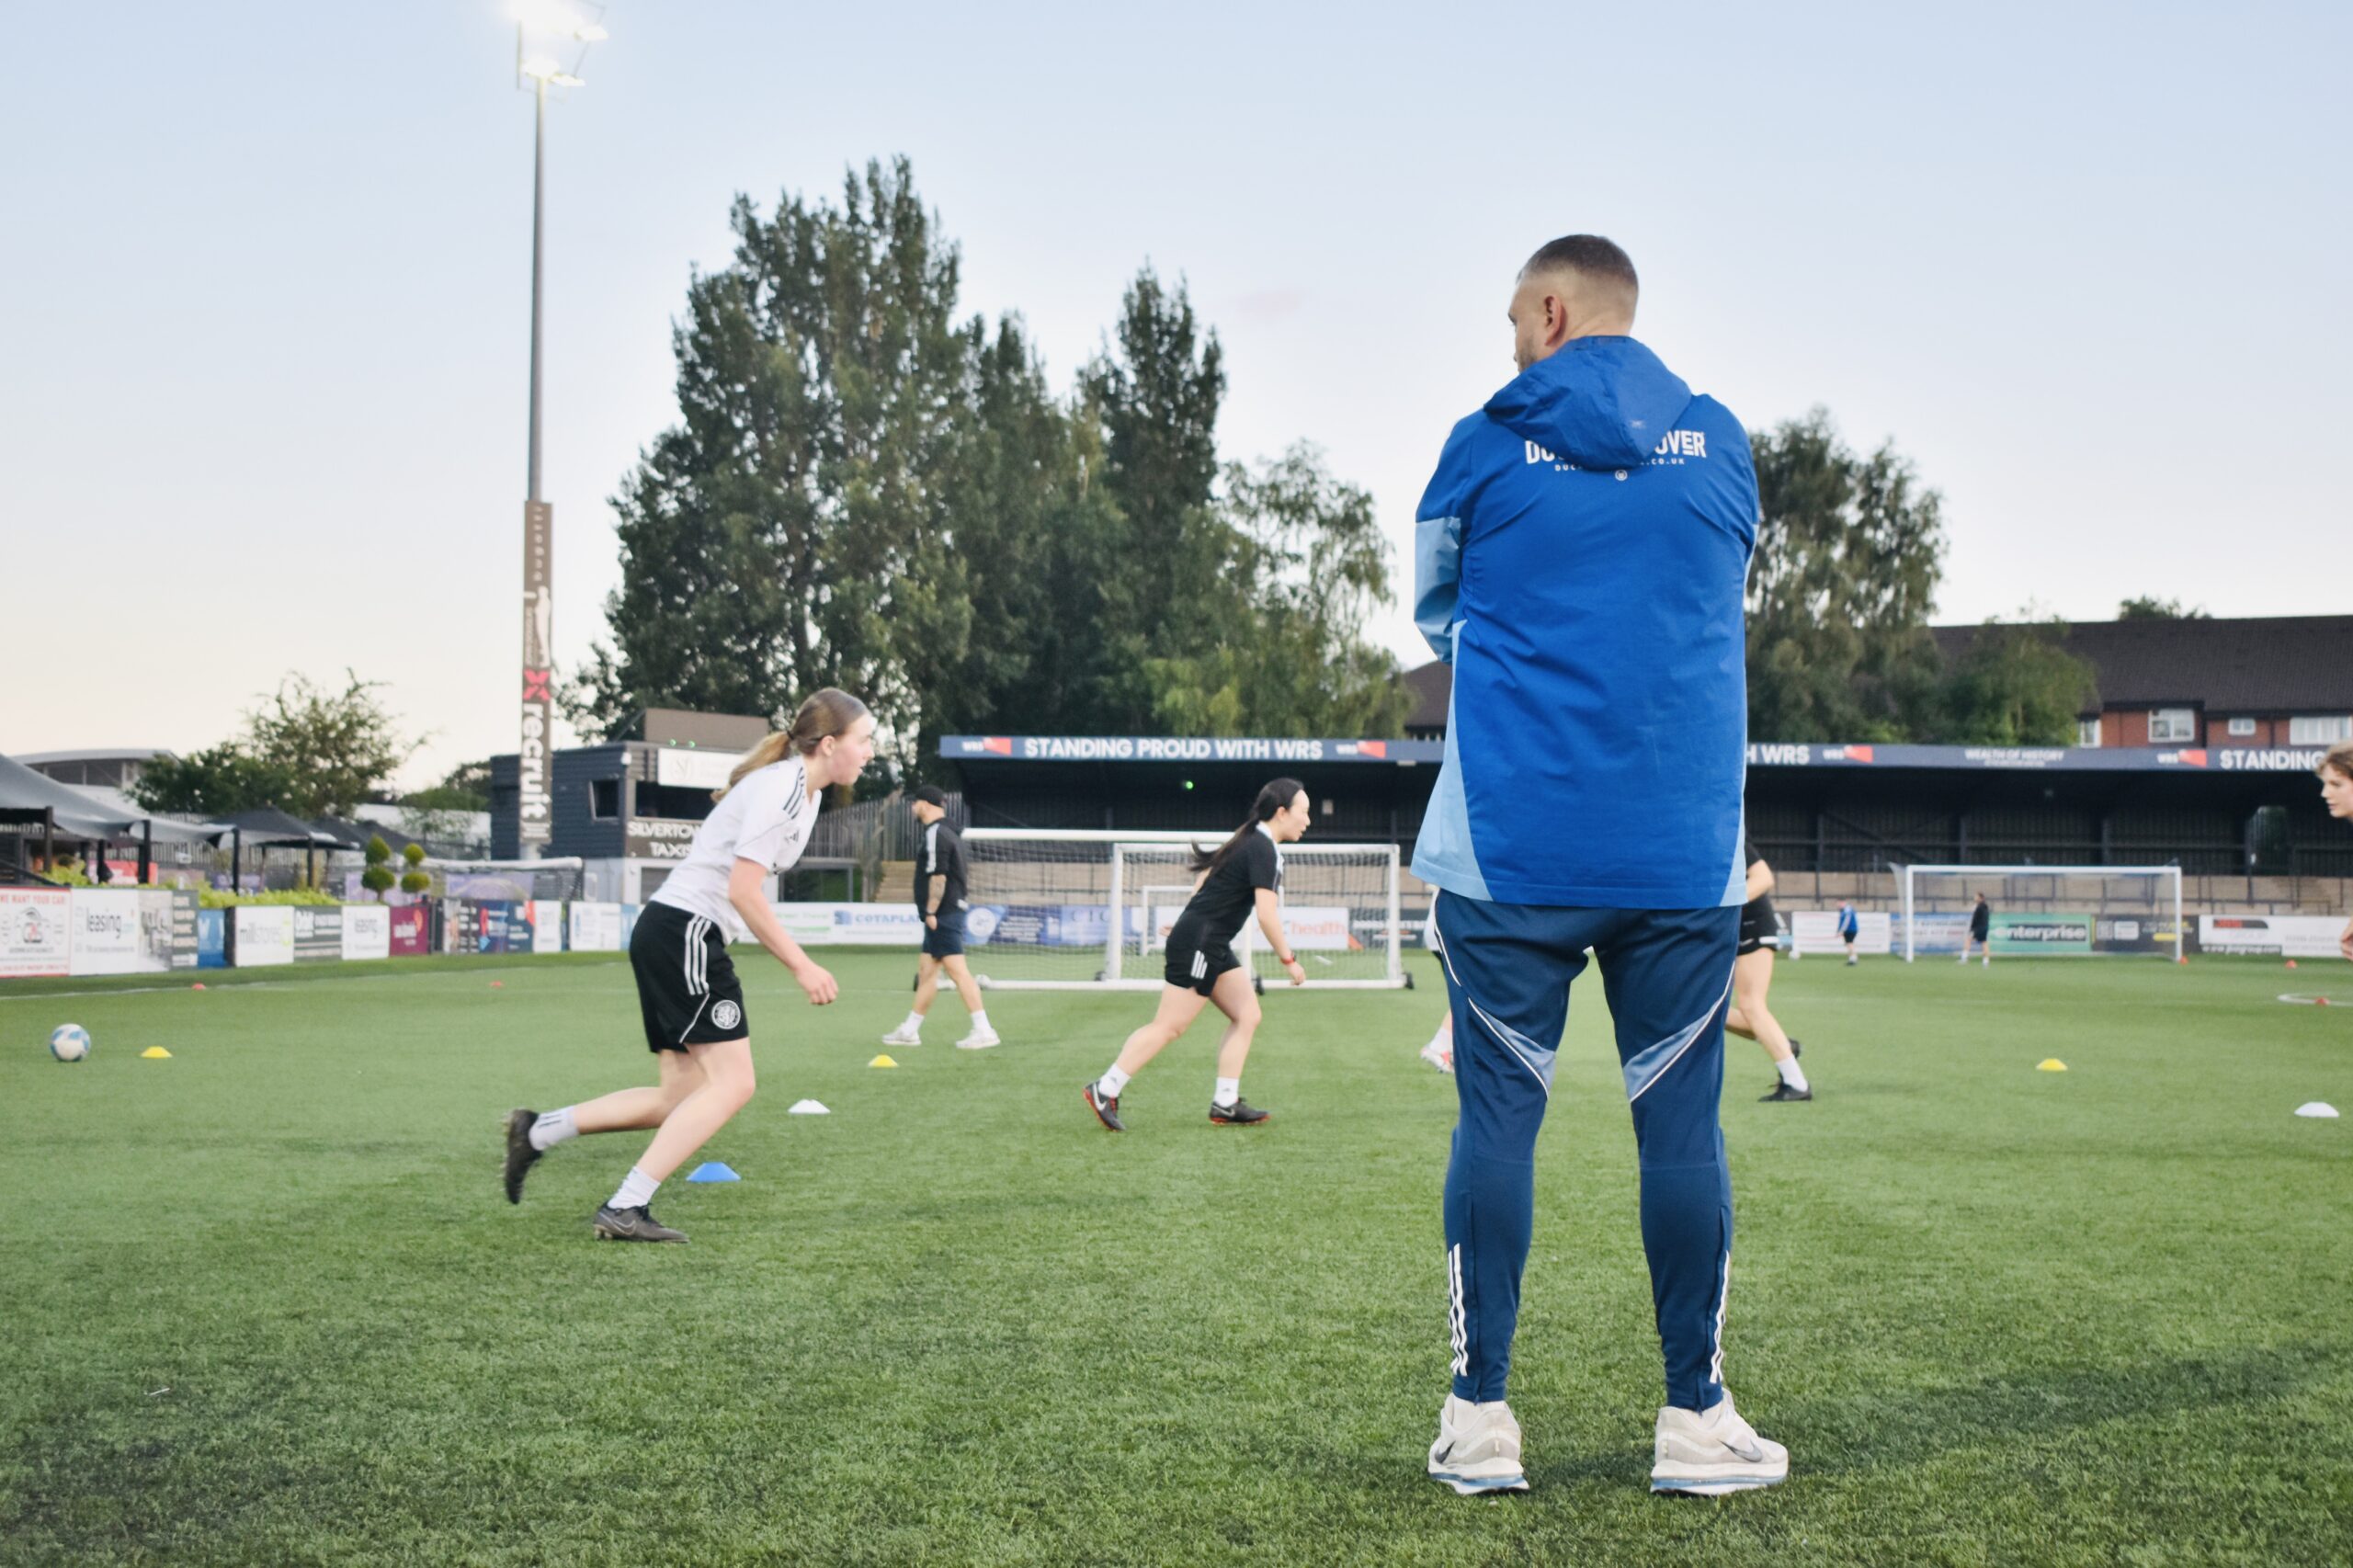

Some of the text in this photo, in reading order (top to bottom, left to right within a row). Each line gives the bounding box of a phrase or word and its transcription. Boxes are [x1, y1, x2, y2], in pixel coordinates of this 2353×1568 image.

[1024, 738, 1324, 760] STANDING PROUD WITH WRS
[1761, 744, 1811, 766] WRS
[521, 704, 551, 818] recruit
[1994, 924, 2086, 942] enterprise
